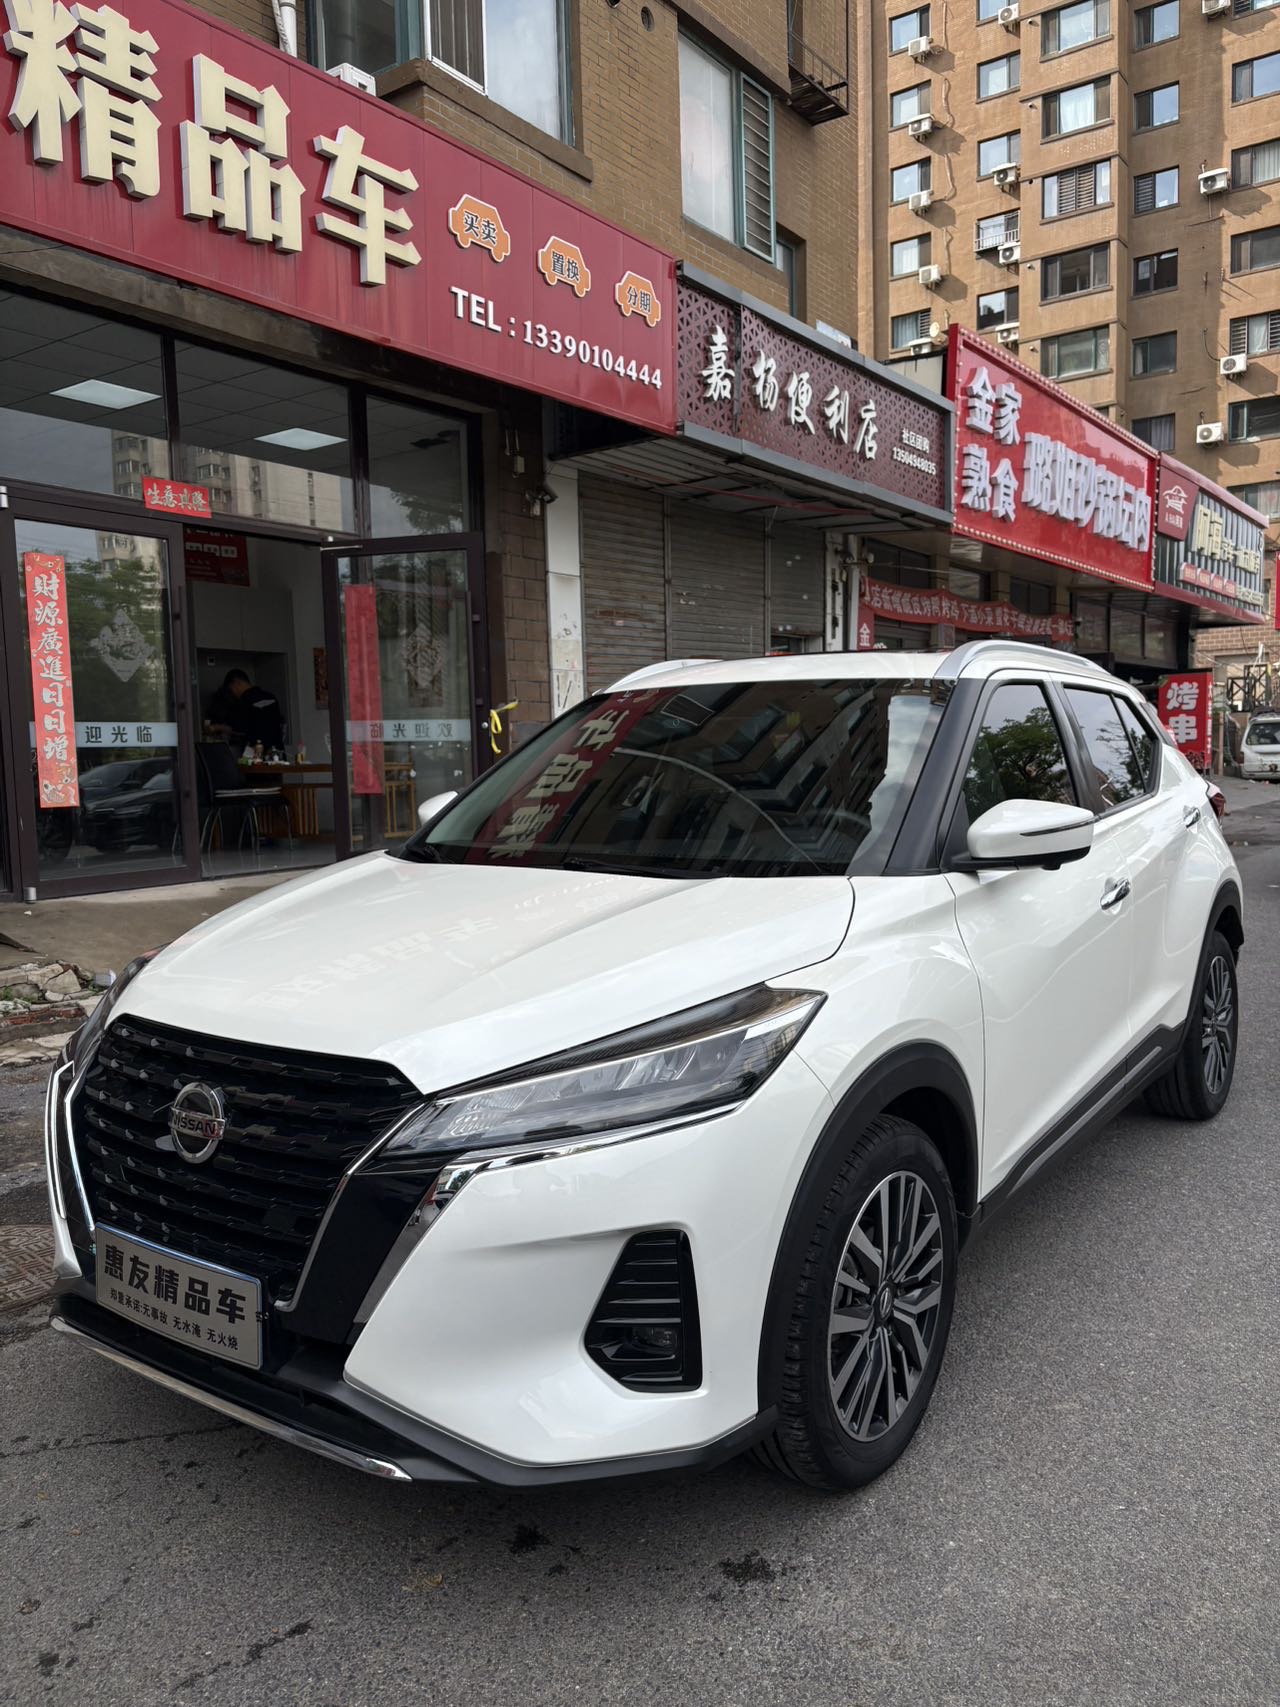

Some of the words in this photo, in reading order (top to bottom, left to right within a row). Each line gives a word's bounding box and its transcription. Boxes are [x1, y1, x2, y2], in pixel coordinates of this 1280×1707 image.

[463, 209, 497, 246] 买卖
[551, 250, 581, 283] 置换
[627, 285, 651, 315] 分期
[522, 320, 663, 390] 13390104444
[966, 367, 1022, 445] 金家
[961, 443, 1019, 522] 熟食
[1166, 681, 1200, 744] 烤串
[172, 1111, 217, 1136] NISSAN
[104, 1244, 247, 1325] 惠友精品车
[206, 1327, 239, 1351] 无火烧
